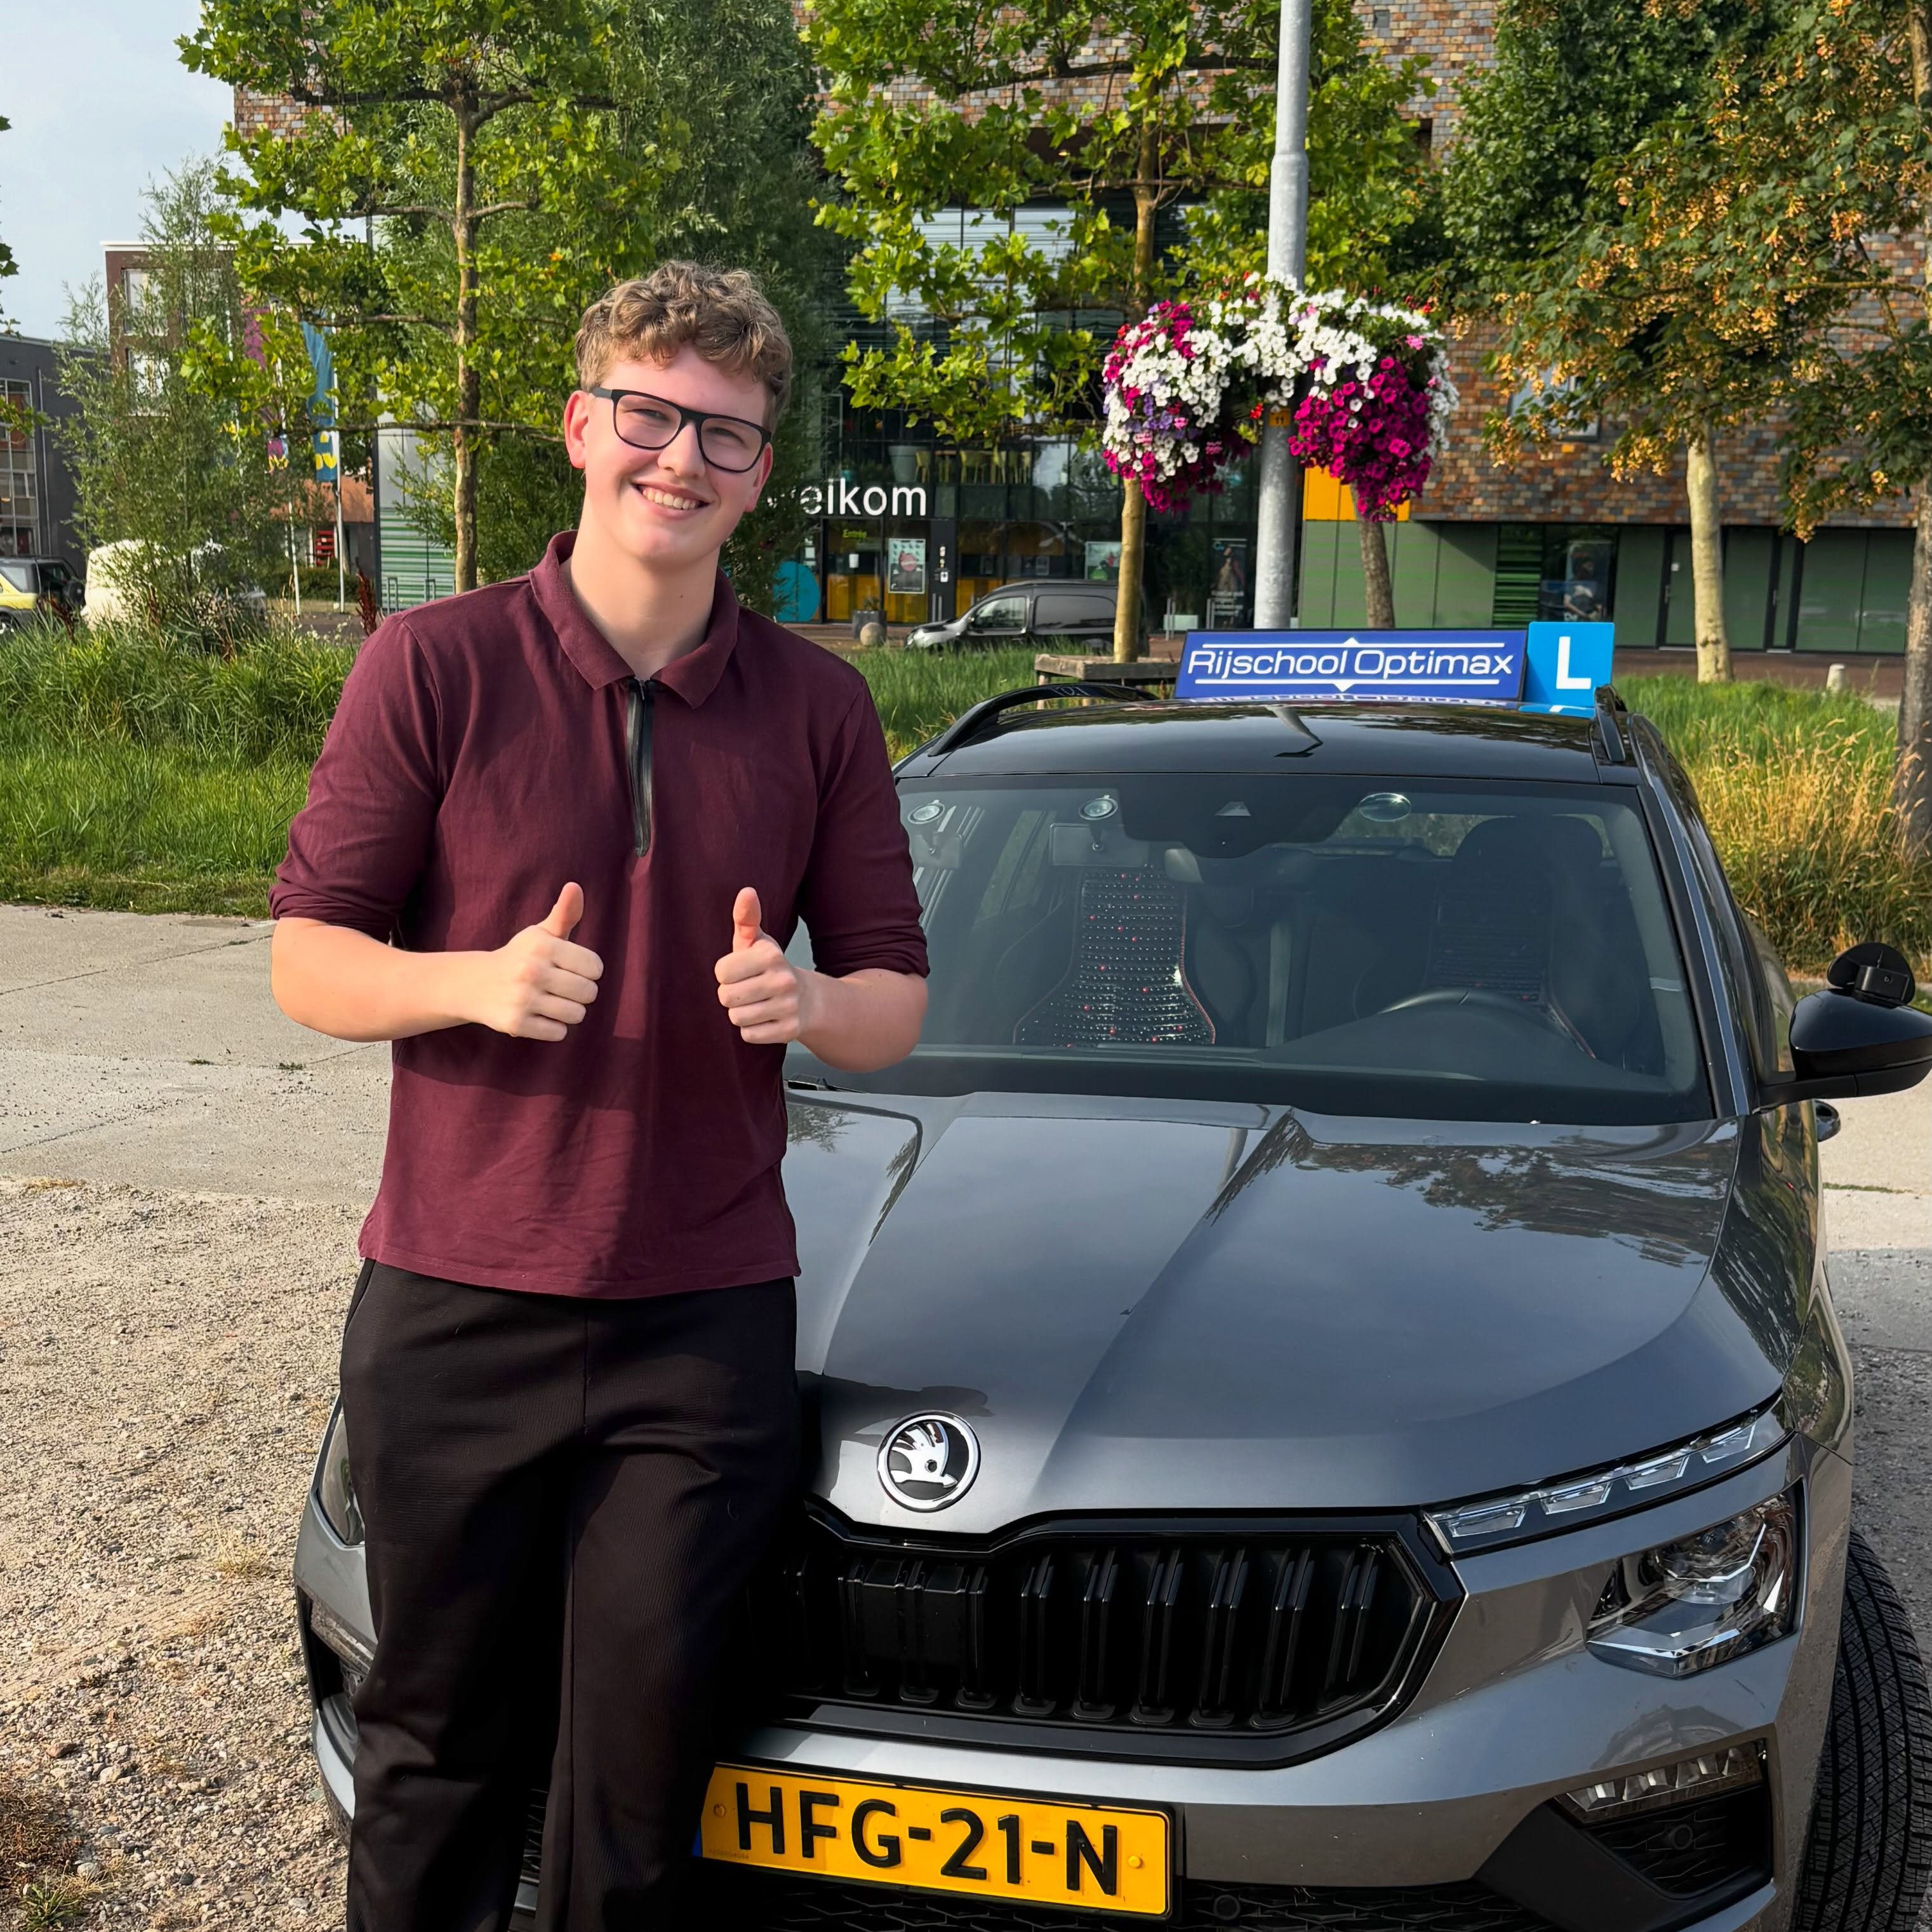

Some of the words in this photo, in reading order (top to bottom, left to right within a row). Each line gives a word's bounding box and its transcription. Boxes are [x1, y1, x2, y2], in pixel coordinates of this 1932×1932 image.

[766, 477, 926, 516] elkom
[1188, 650, 1348, 679] Rijschool
[1354, 650, 1514, 679] Optimax
[1556, 636, 1591, 689] L
[736, 1783, 1117, 1895] HFG-21-N
